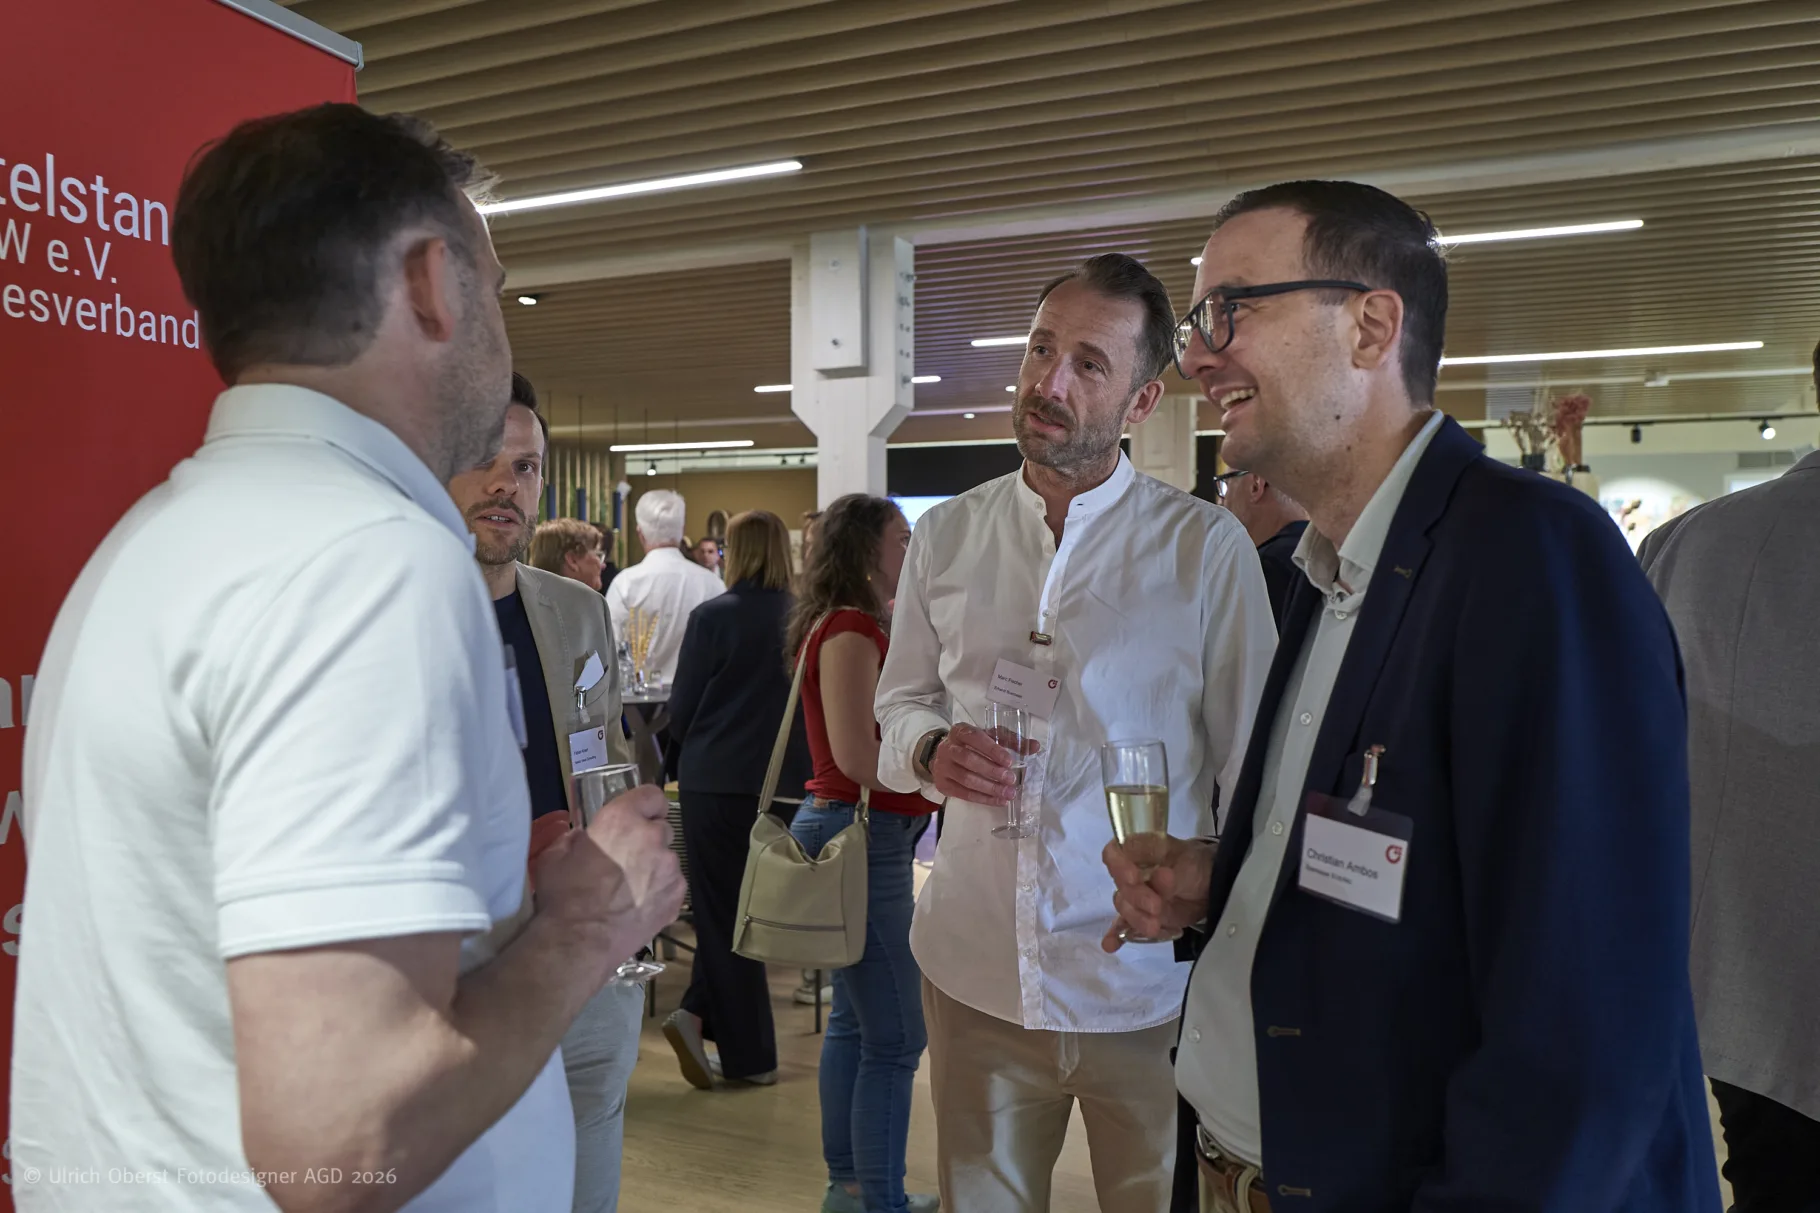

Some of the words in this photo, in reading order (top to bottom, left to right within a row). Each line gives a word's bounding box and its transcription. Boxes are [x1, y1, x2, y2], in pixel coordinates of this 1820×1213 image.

[0, 152, 169, 245] elstan
[47, 236, 117, 284] e.V.
[2, 284, 200, 349] esverband
[1307, 848, 1344, 868] Christian
[1347, 861, 1378, 879] Ambos
